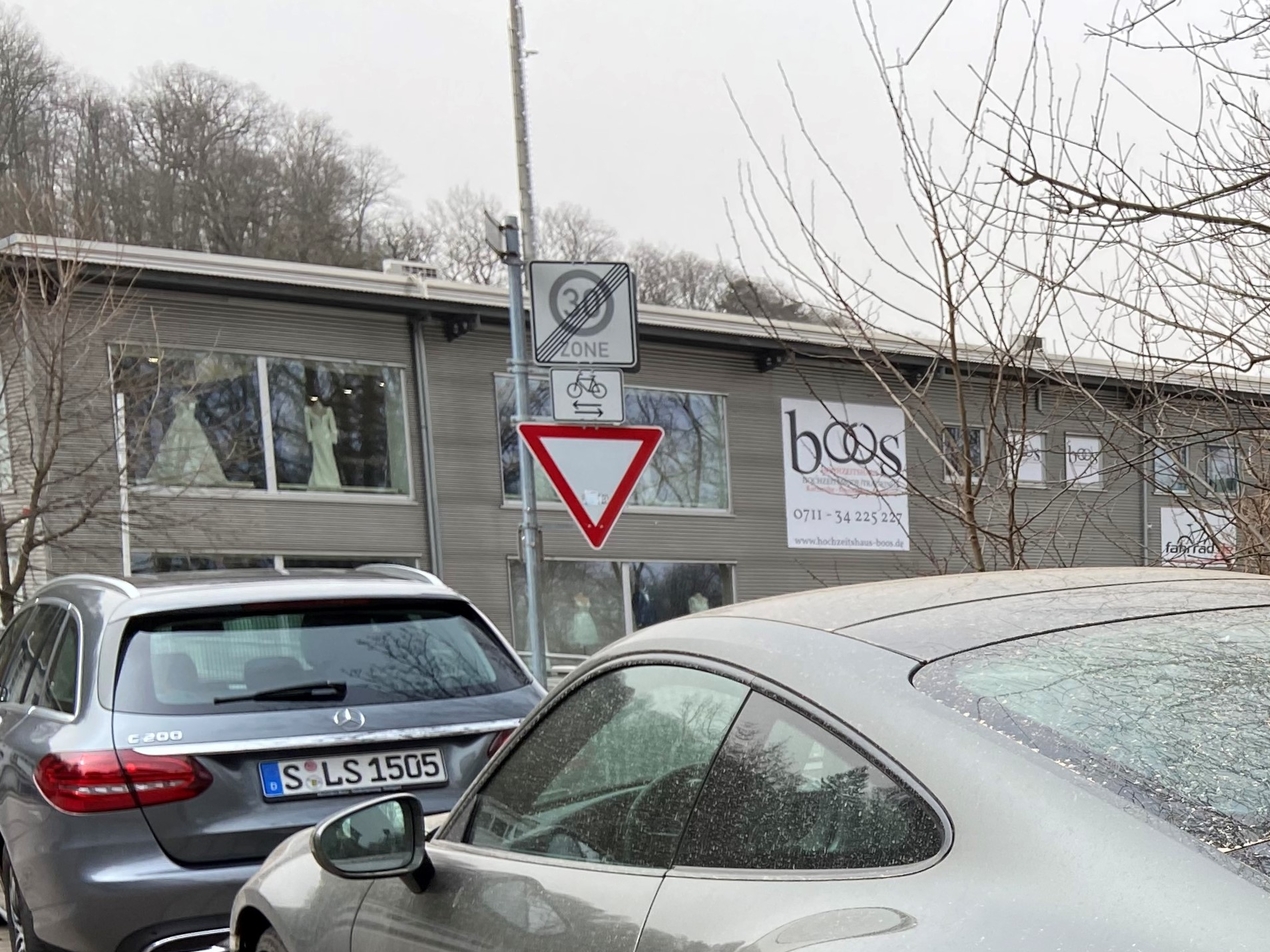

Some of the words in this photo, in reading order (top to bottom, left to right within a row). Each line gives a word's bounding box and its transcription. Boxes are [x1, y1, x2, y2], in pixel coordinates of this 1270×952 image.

[562, 288, 600, 318] 30
[560, 341, 609, 358] ZONE
[784, 409, 902, 478] boos
[793, 508, 822, 524] 0711
[835, 511, 851, 525] 34
[855, 512, 878, 527] 225
[881, 513, 903, 526] 227
[127, 734, 140, 745] C
[143, 731, 183, 743] 200
[282, 764, 304, 791] S
[321, 758, 364, 787] LS
[368, 752, 441, 783] 1505
